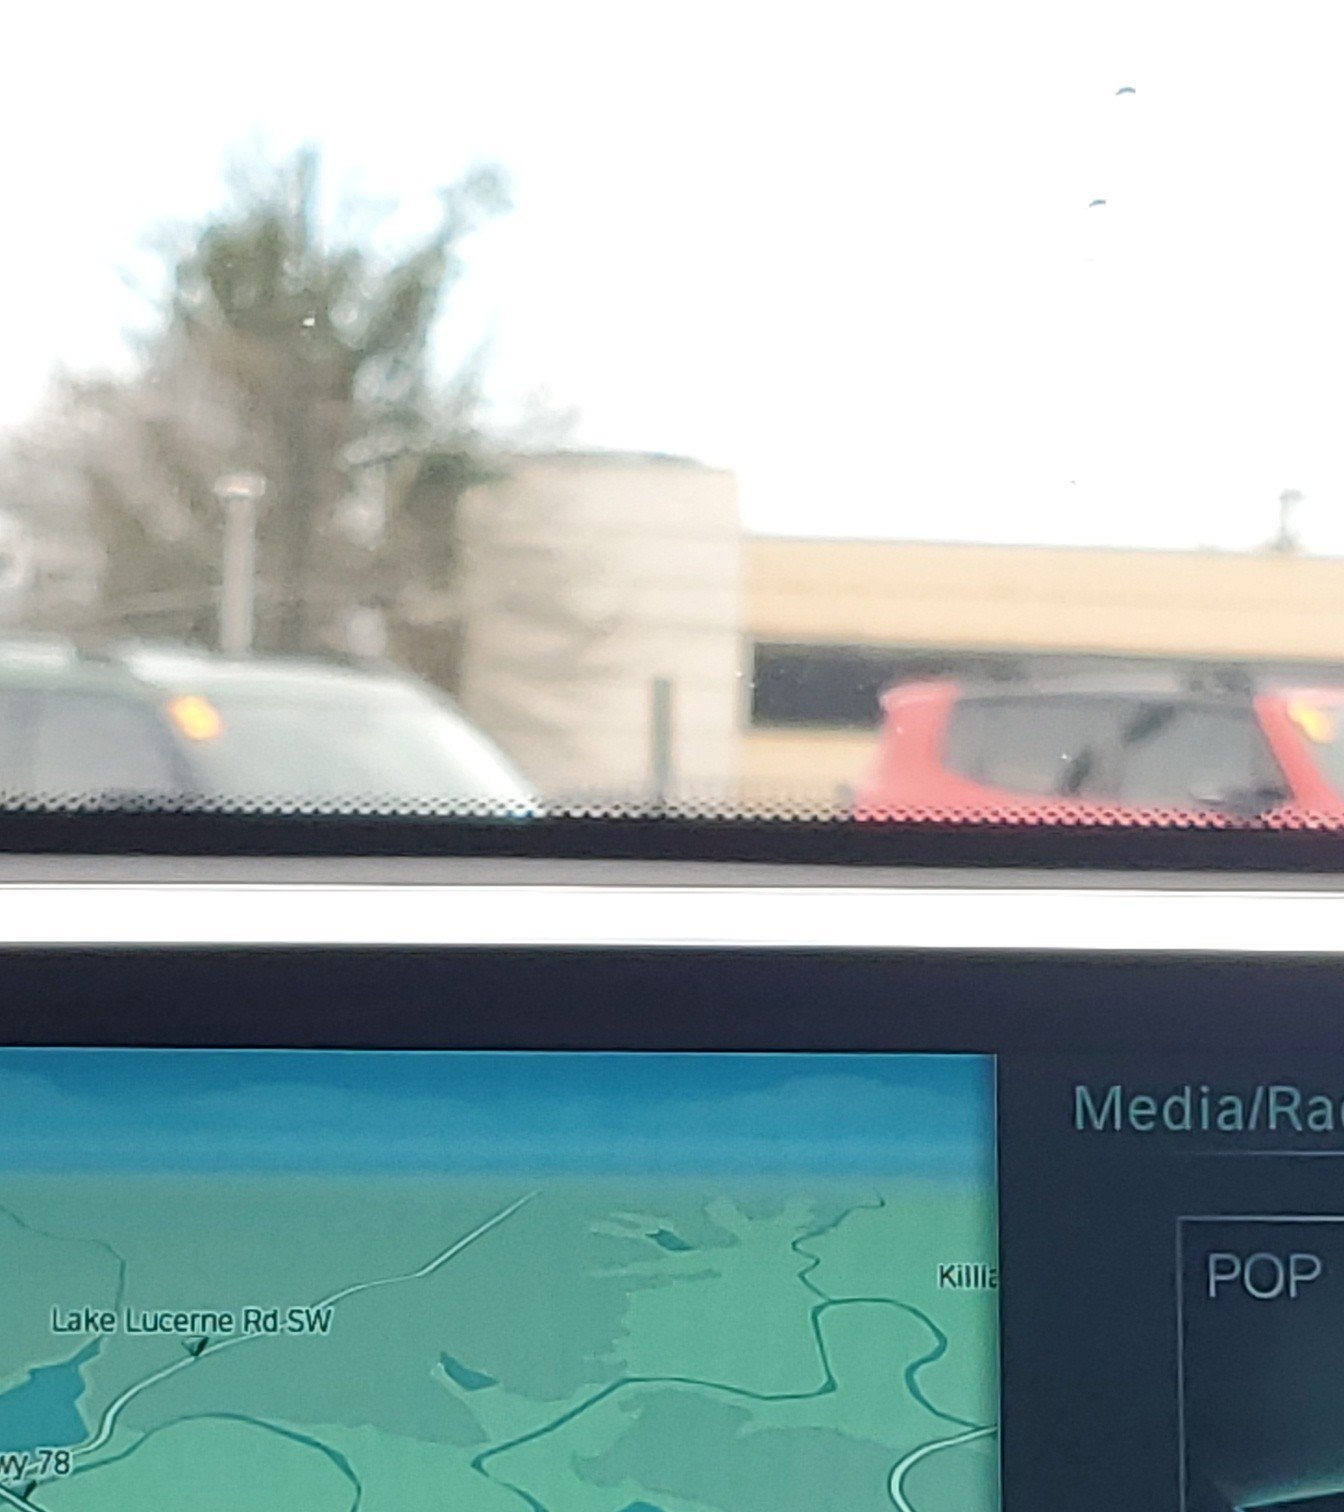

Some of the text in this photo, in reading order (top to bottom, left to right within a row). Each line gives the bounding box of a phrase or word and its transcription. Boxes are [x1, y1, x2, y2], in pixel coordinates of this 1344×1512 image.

[1206, 1252, 1323, 1300] POP
[52, 1306, 116, 1335] Lake
[125, 1307, 234, 1336] Lucerne
[287, 1309, 332, 1337] SW
[36, 1451, 72, 1477] 78
